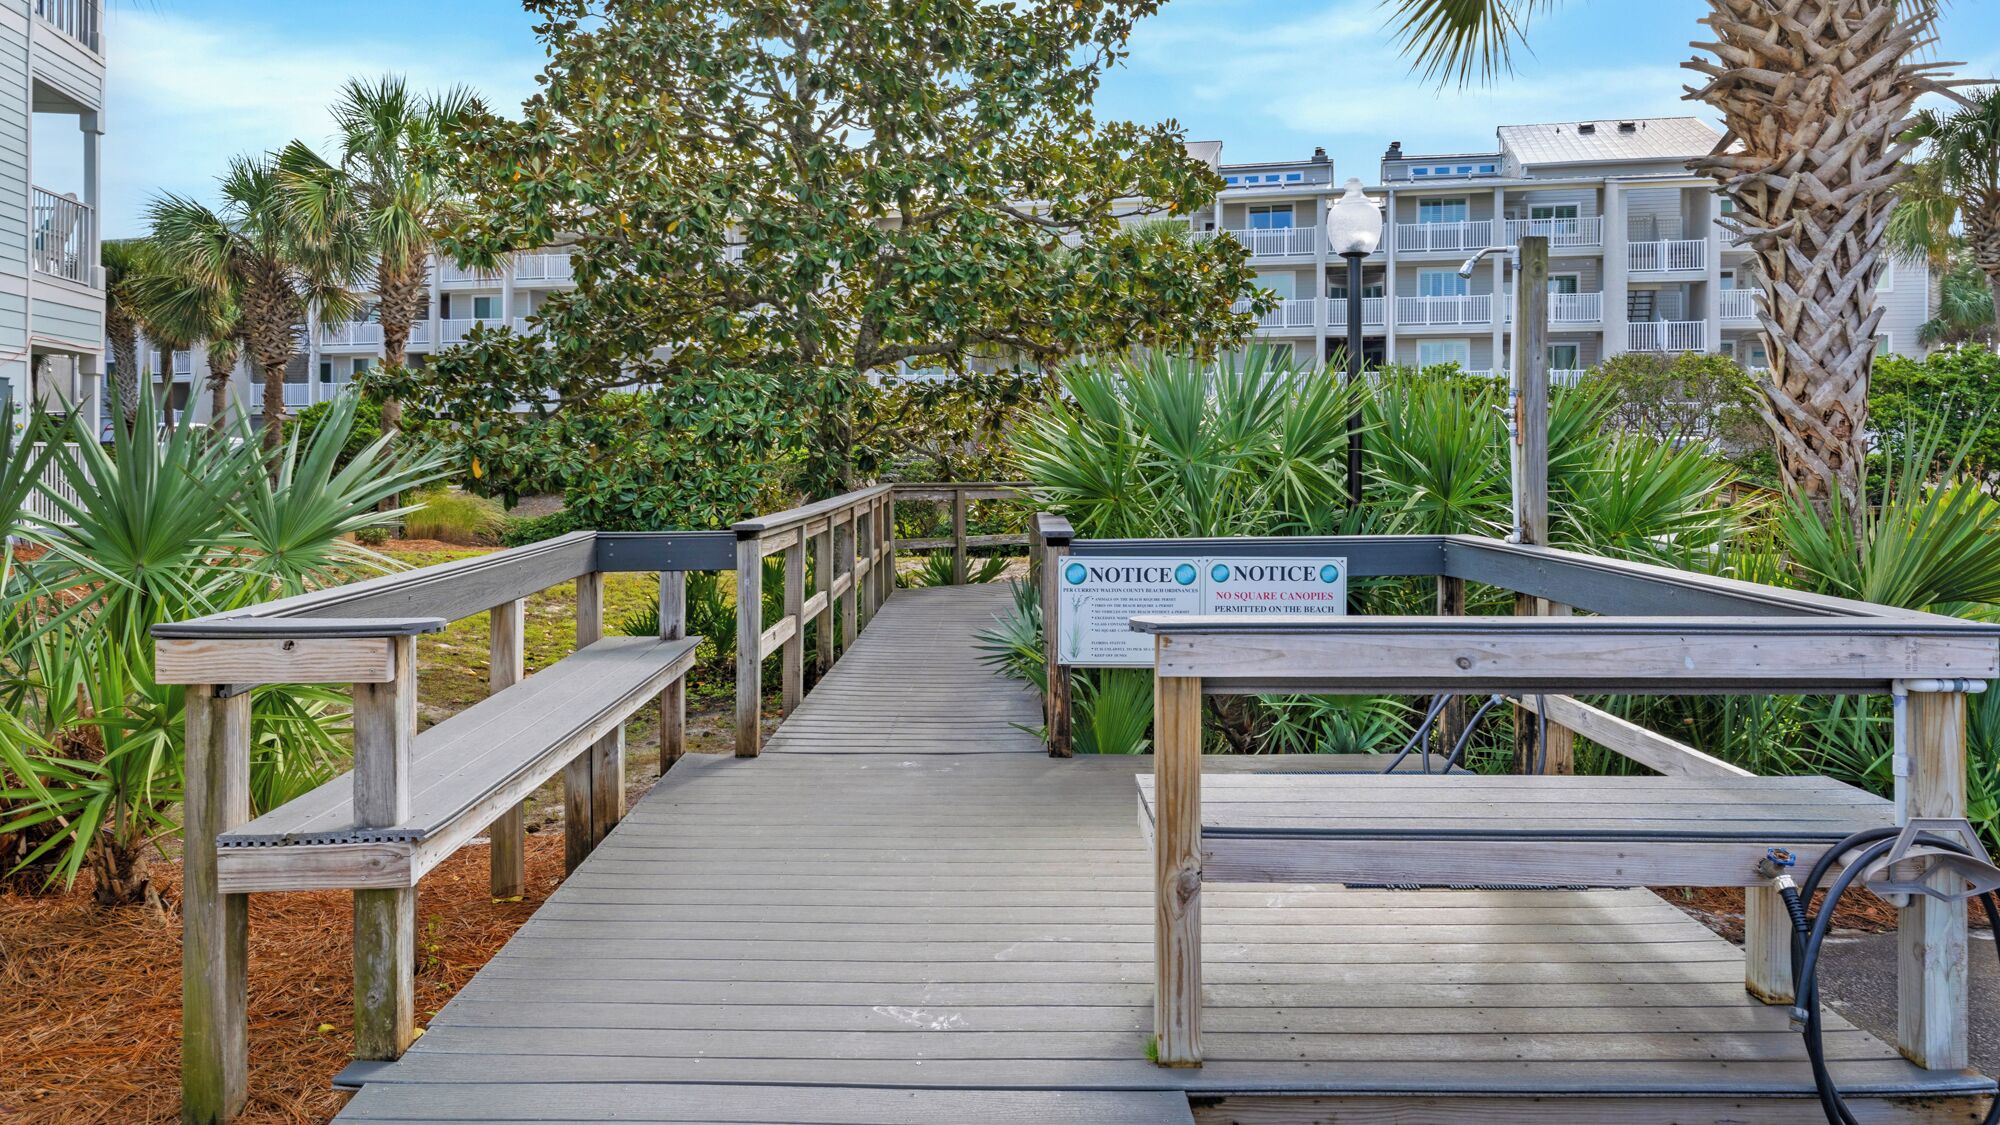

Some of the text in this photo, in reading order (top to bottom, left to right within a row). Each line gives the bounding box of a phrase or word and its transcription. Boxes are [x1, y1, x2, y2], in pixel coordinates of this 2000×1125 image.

[1089, 566, 1173, 583] NOTICE
[1233, 565, 1316, 582] NOTICE
[1216, 591, 1334, 602] NO SQUARE CANOPIES
[1215, 605, 1334, 613] PERMITTED ON THE BEACH
